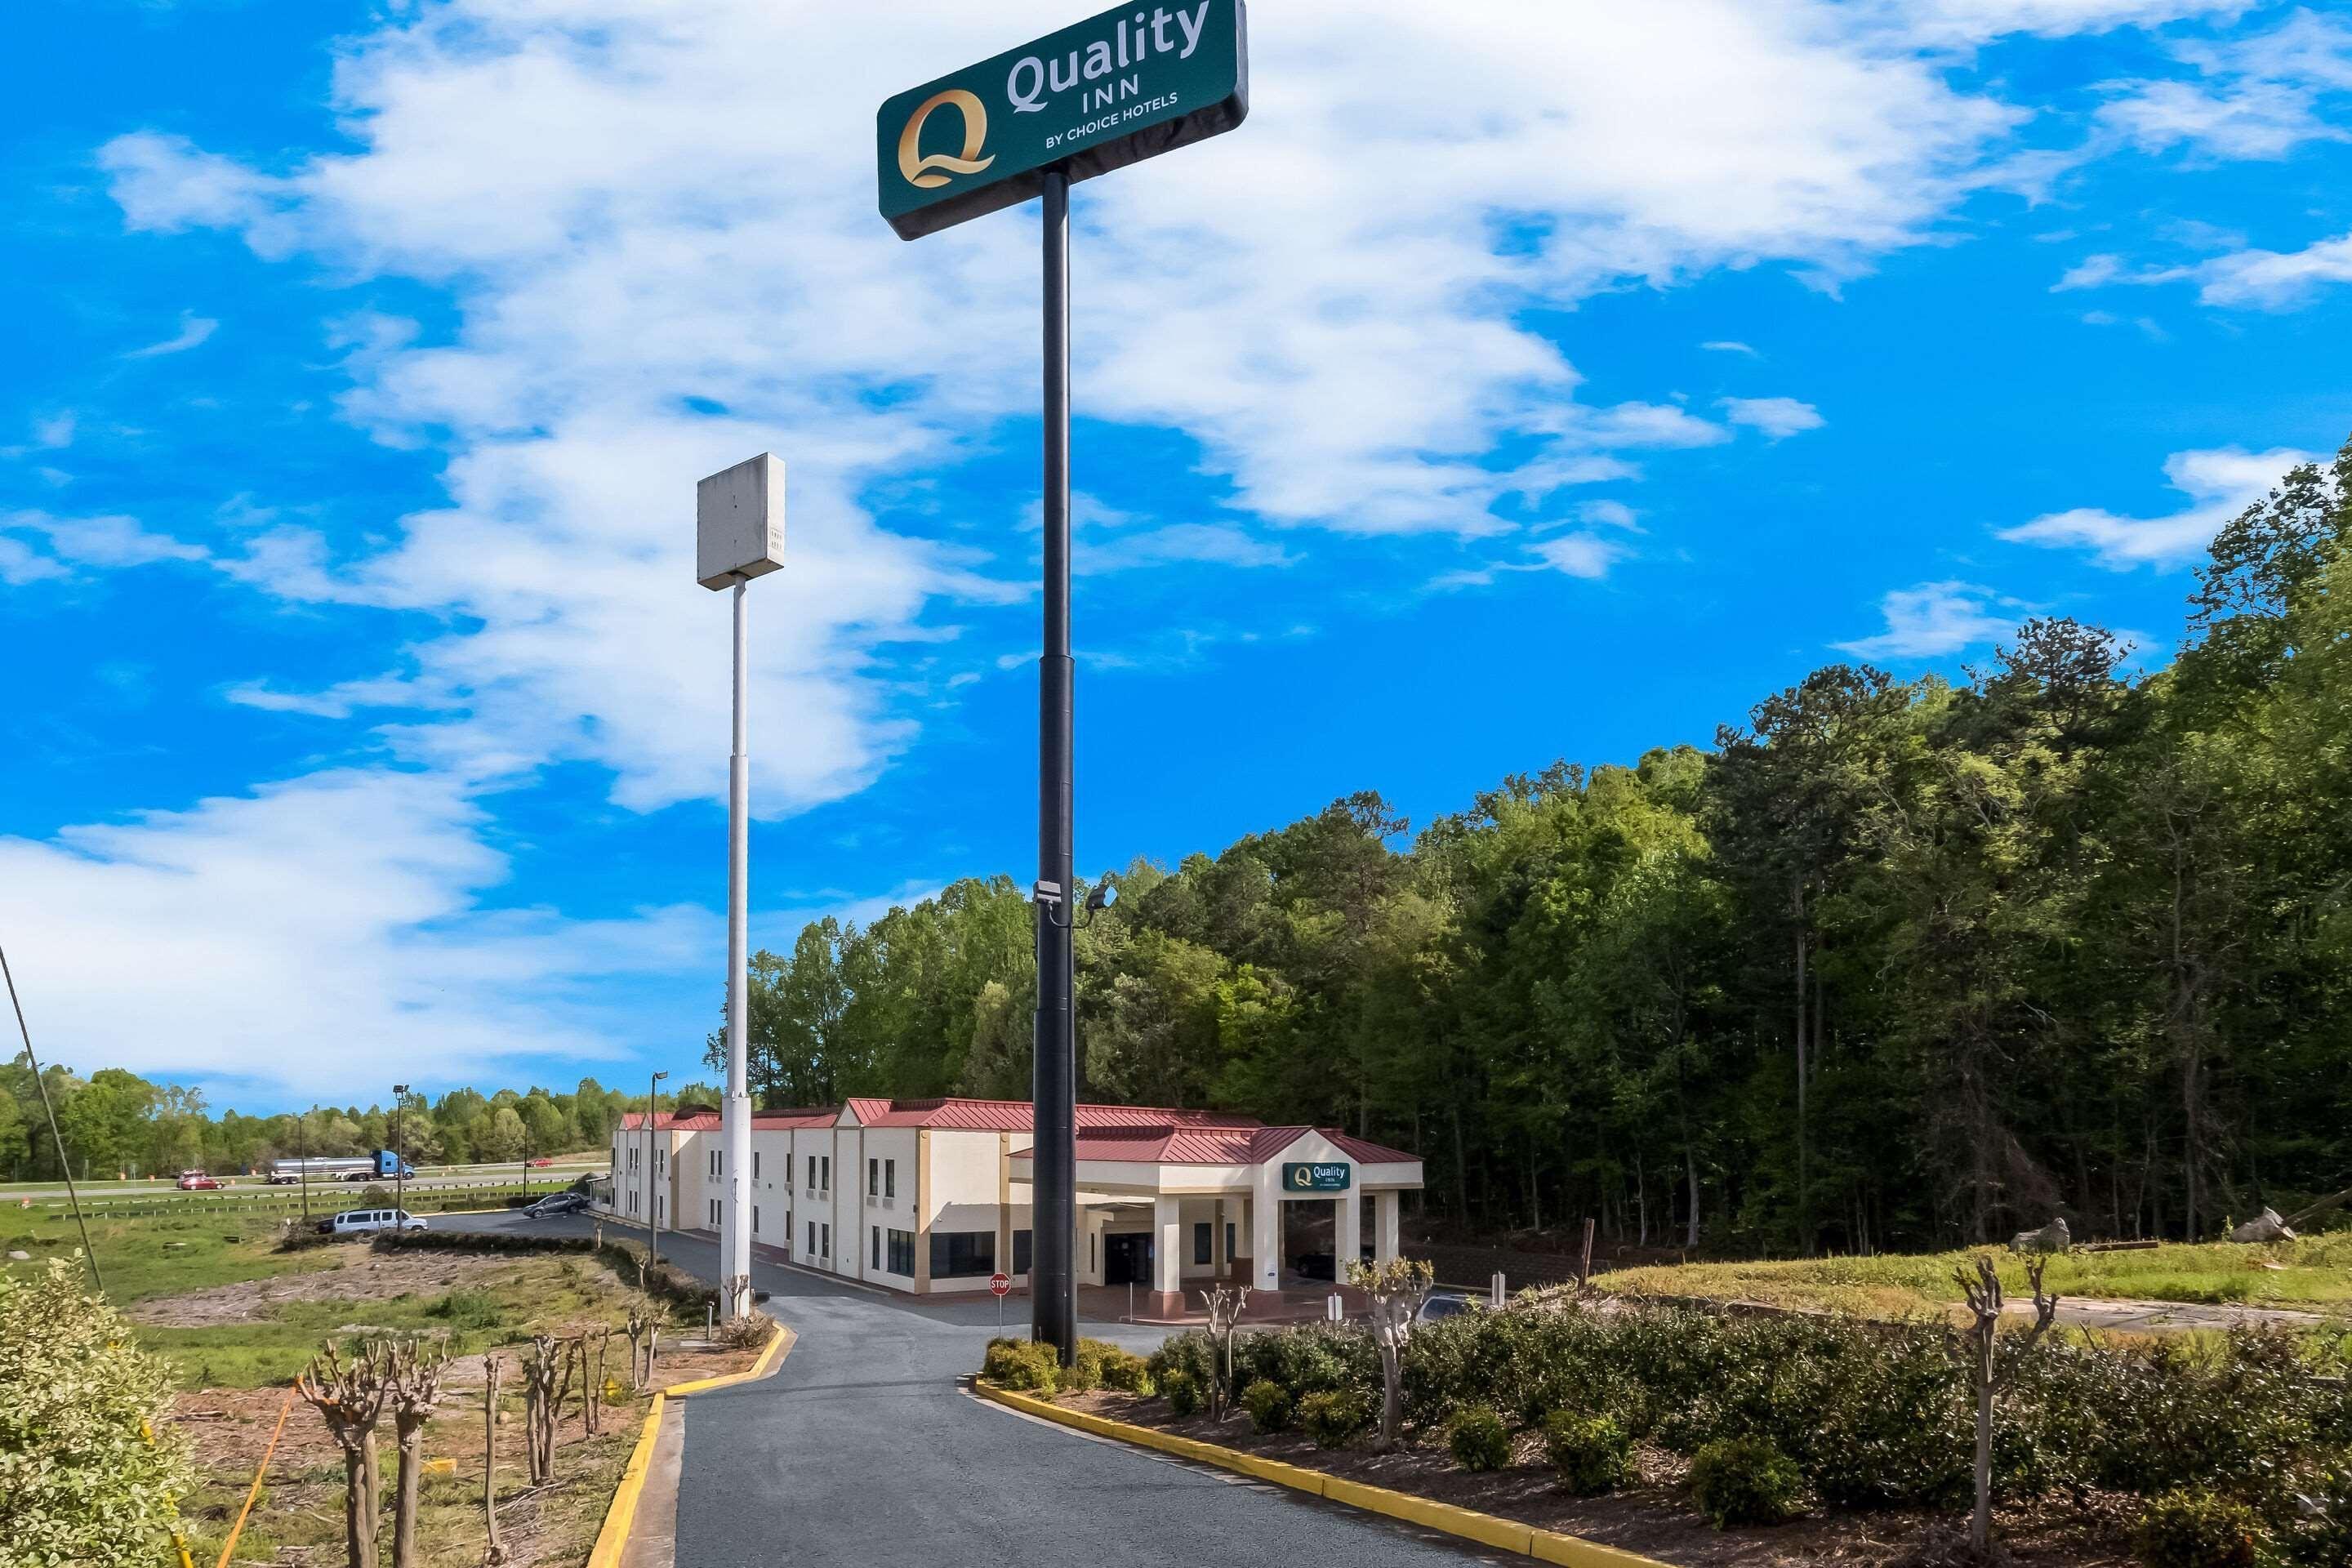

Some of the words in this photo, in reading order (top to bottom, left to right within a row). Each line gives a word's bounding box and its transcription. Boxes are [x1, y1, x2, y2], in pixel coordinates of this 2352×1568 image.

[1007, 0, 1209, 114] Quality
[1083, 74, 1138, 114] INN
[898, 89, 996, 189] Q
[1045, 133, 1063, 149] BY
[1067, 113, 1119, 140] CHOICE
[1123, 91, 1178, 121] HOTELS
[1313, 1166, 1345, 1178] Quality
[991, 1280, 1009, 1288] STOP
